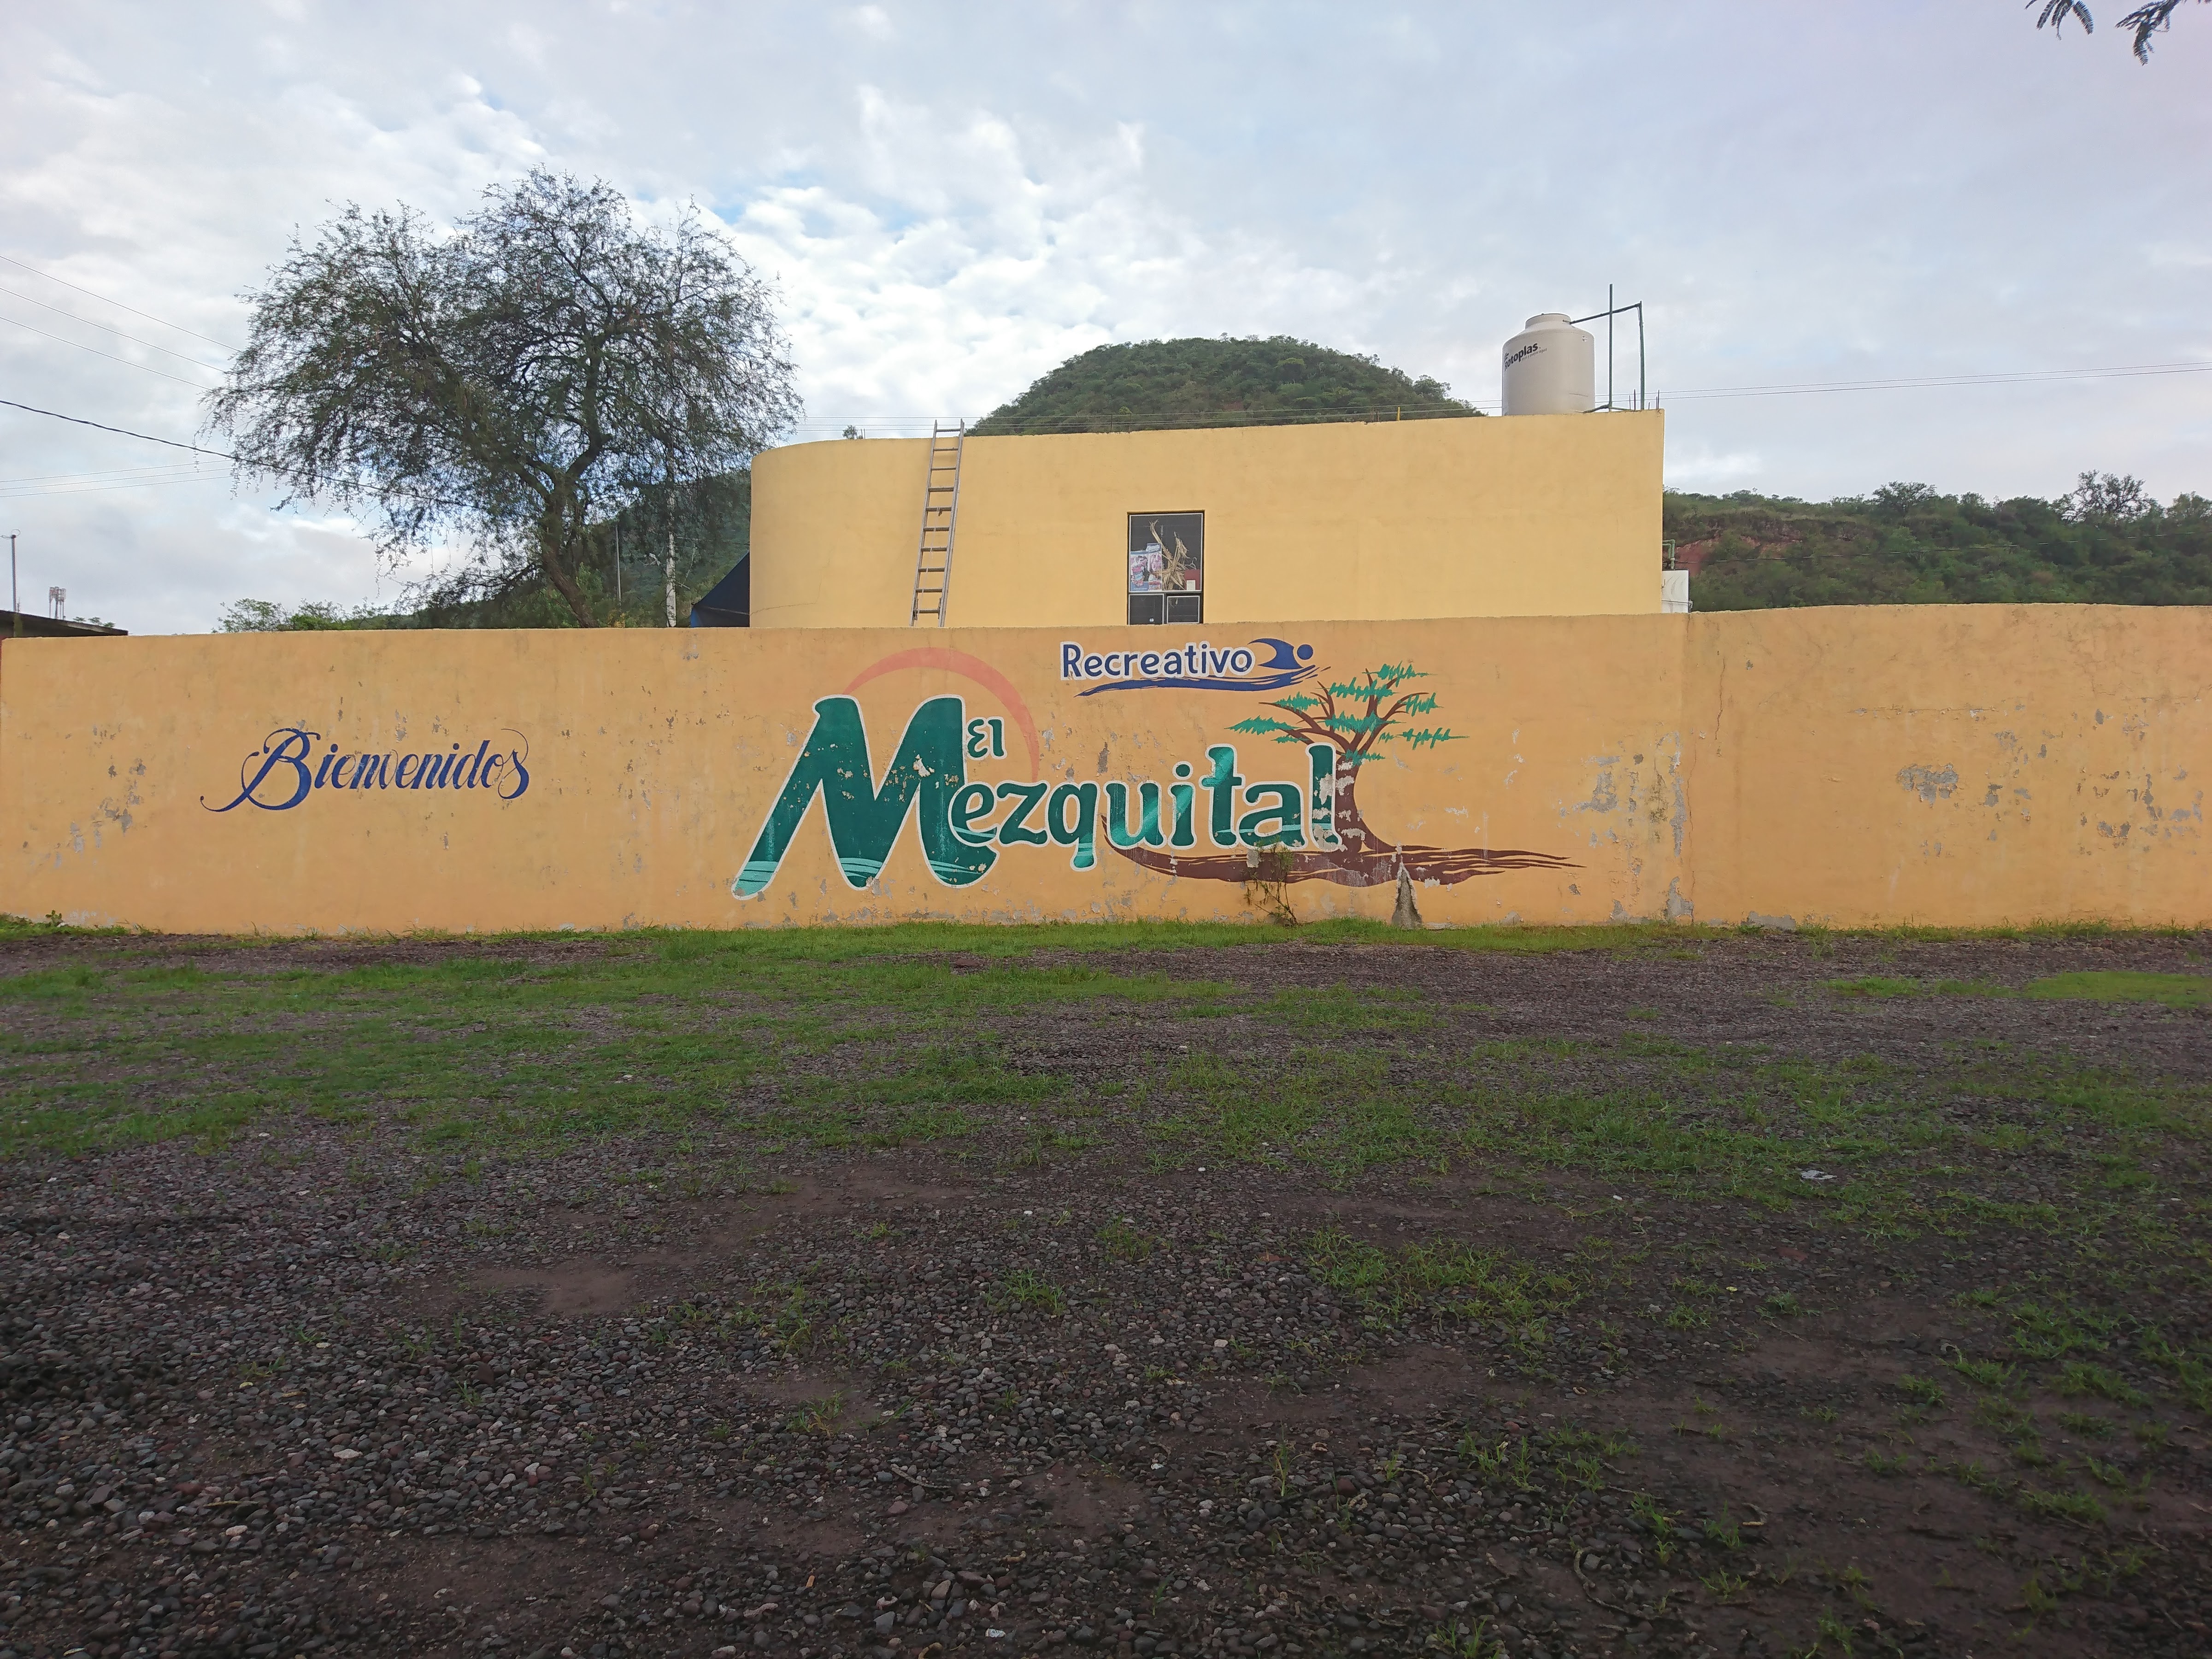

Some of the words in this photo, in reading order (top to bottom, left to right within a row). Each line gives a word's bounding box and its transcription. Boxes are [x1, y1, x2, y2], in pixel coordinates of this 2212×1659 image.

[1505, 343, 1538, 372] Rotoplas
[1062, 643, 1253, 677] Recreativo
[967, 718, 1005, 758] El
[200, 728, 529, 812] Bienvenidos
[733, 695, 1340, 899] Mezquital
